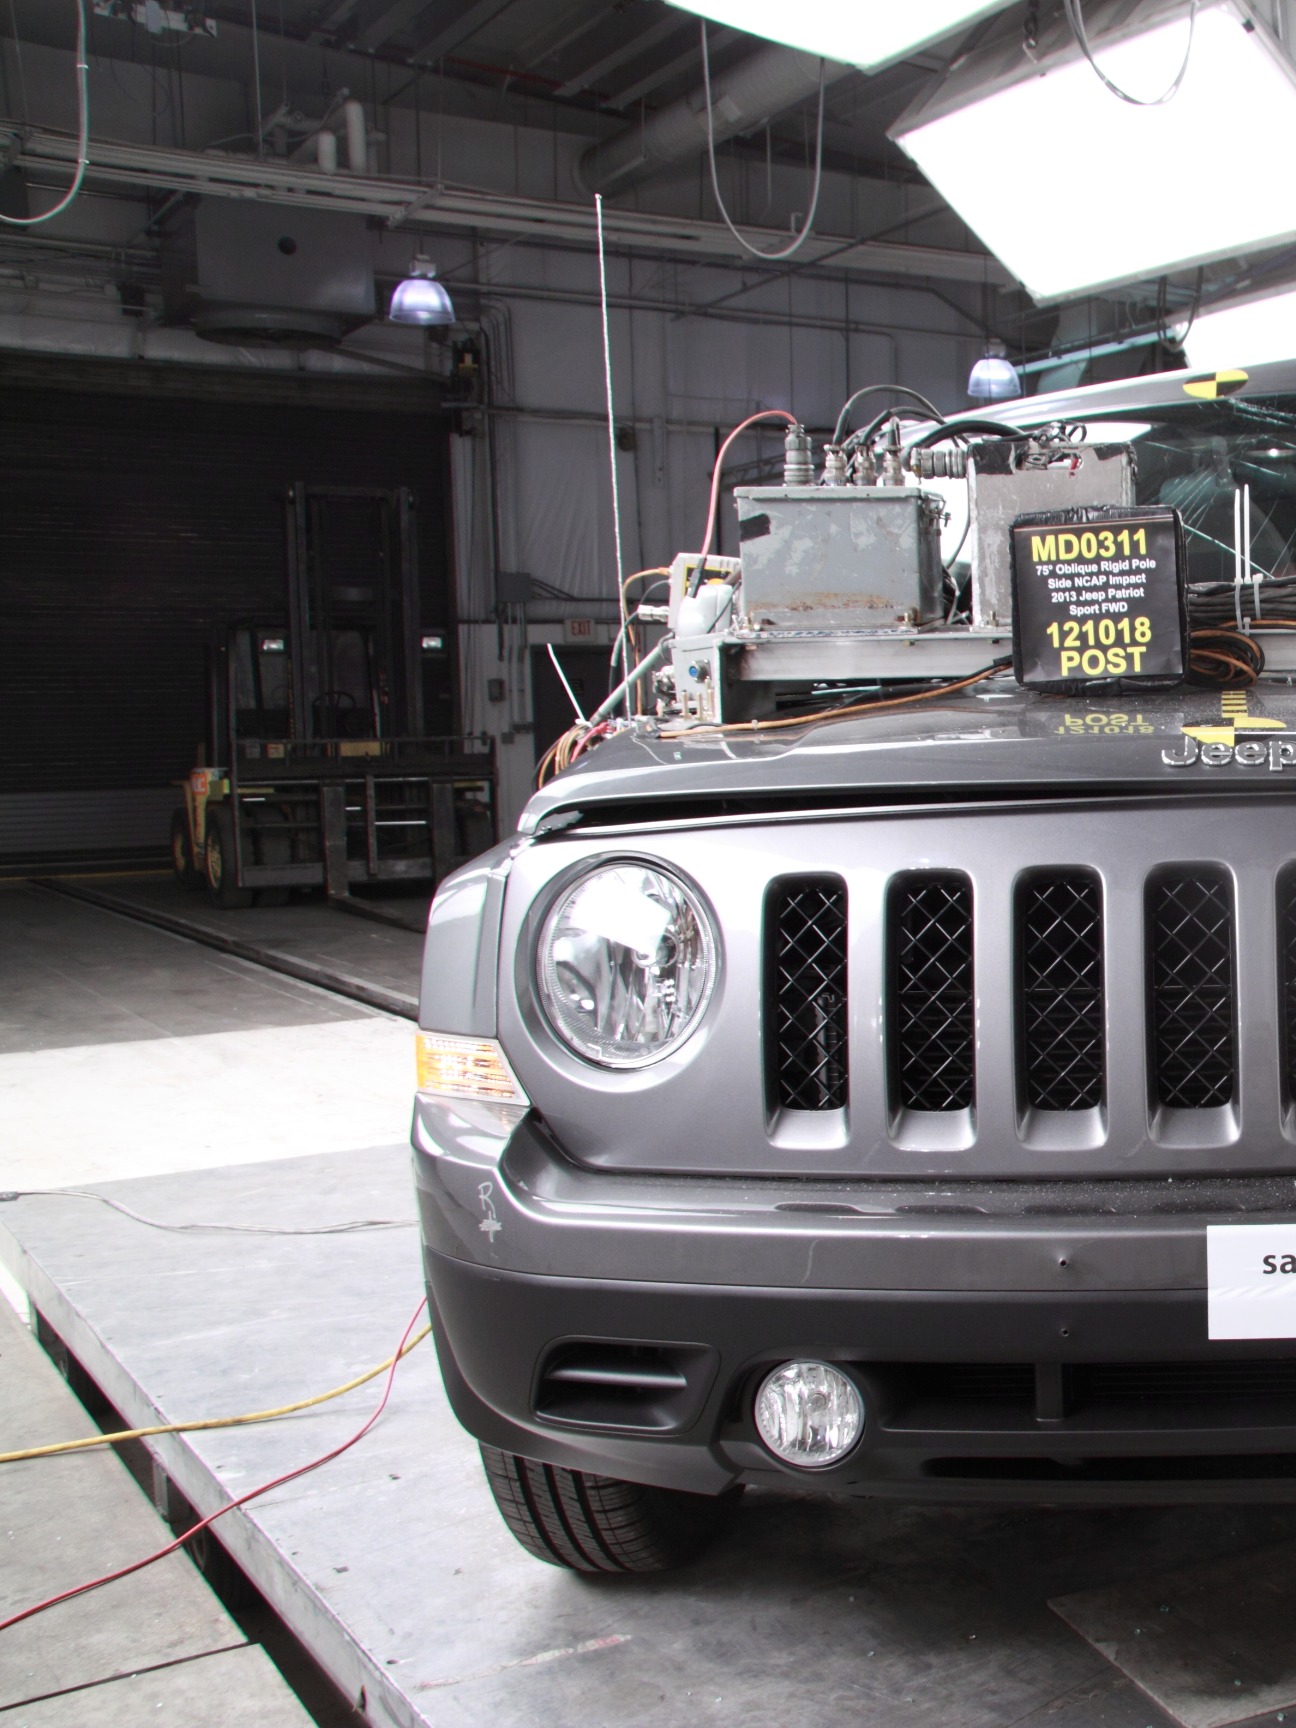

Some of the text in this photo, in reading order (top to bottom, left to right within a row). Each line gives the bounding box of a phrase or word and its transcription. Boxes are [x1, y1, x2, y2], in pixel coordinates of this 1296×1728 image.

[1031, 528, 1147, 562] MD0311
[1056, 562, 1098, 575] Oblique
[1101, 560, 1129, 573] Rigid
[1132, 558, 1156, 569] Pole
[1048, 573, 1146, 589] Side NCAP Impact
[1051, 587, 1144, 603] 2013 Jeep Patriot
[1069, 602, 1128, 617] Sport FWD
[571, 620, 591, 636] EXIT
[1046, 616, 1151, 648] 121018
[1060, 646, 1146, 676] POST
